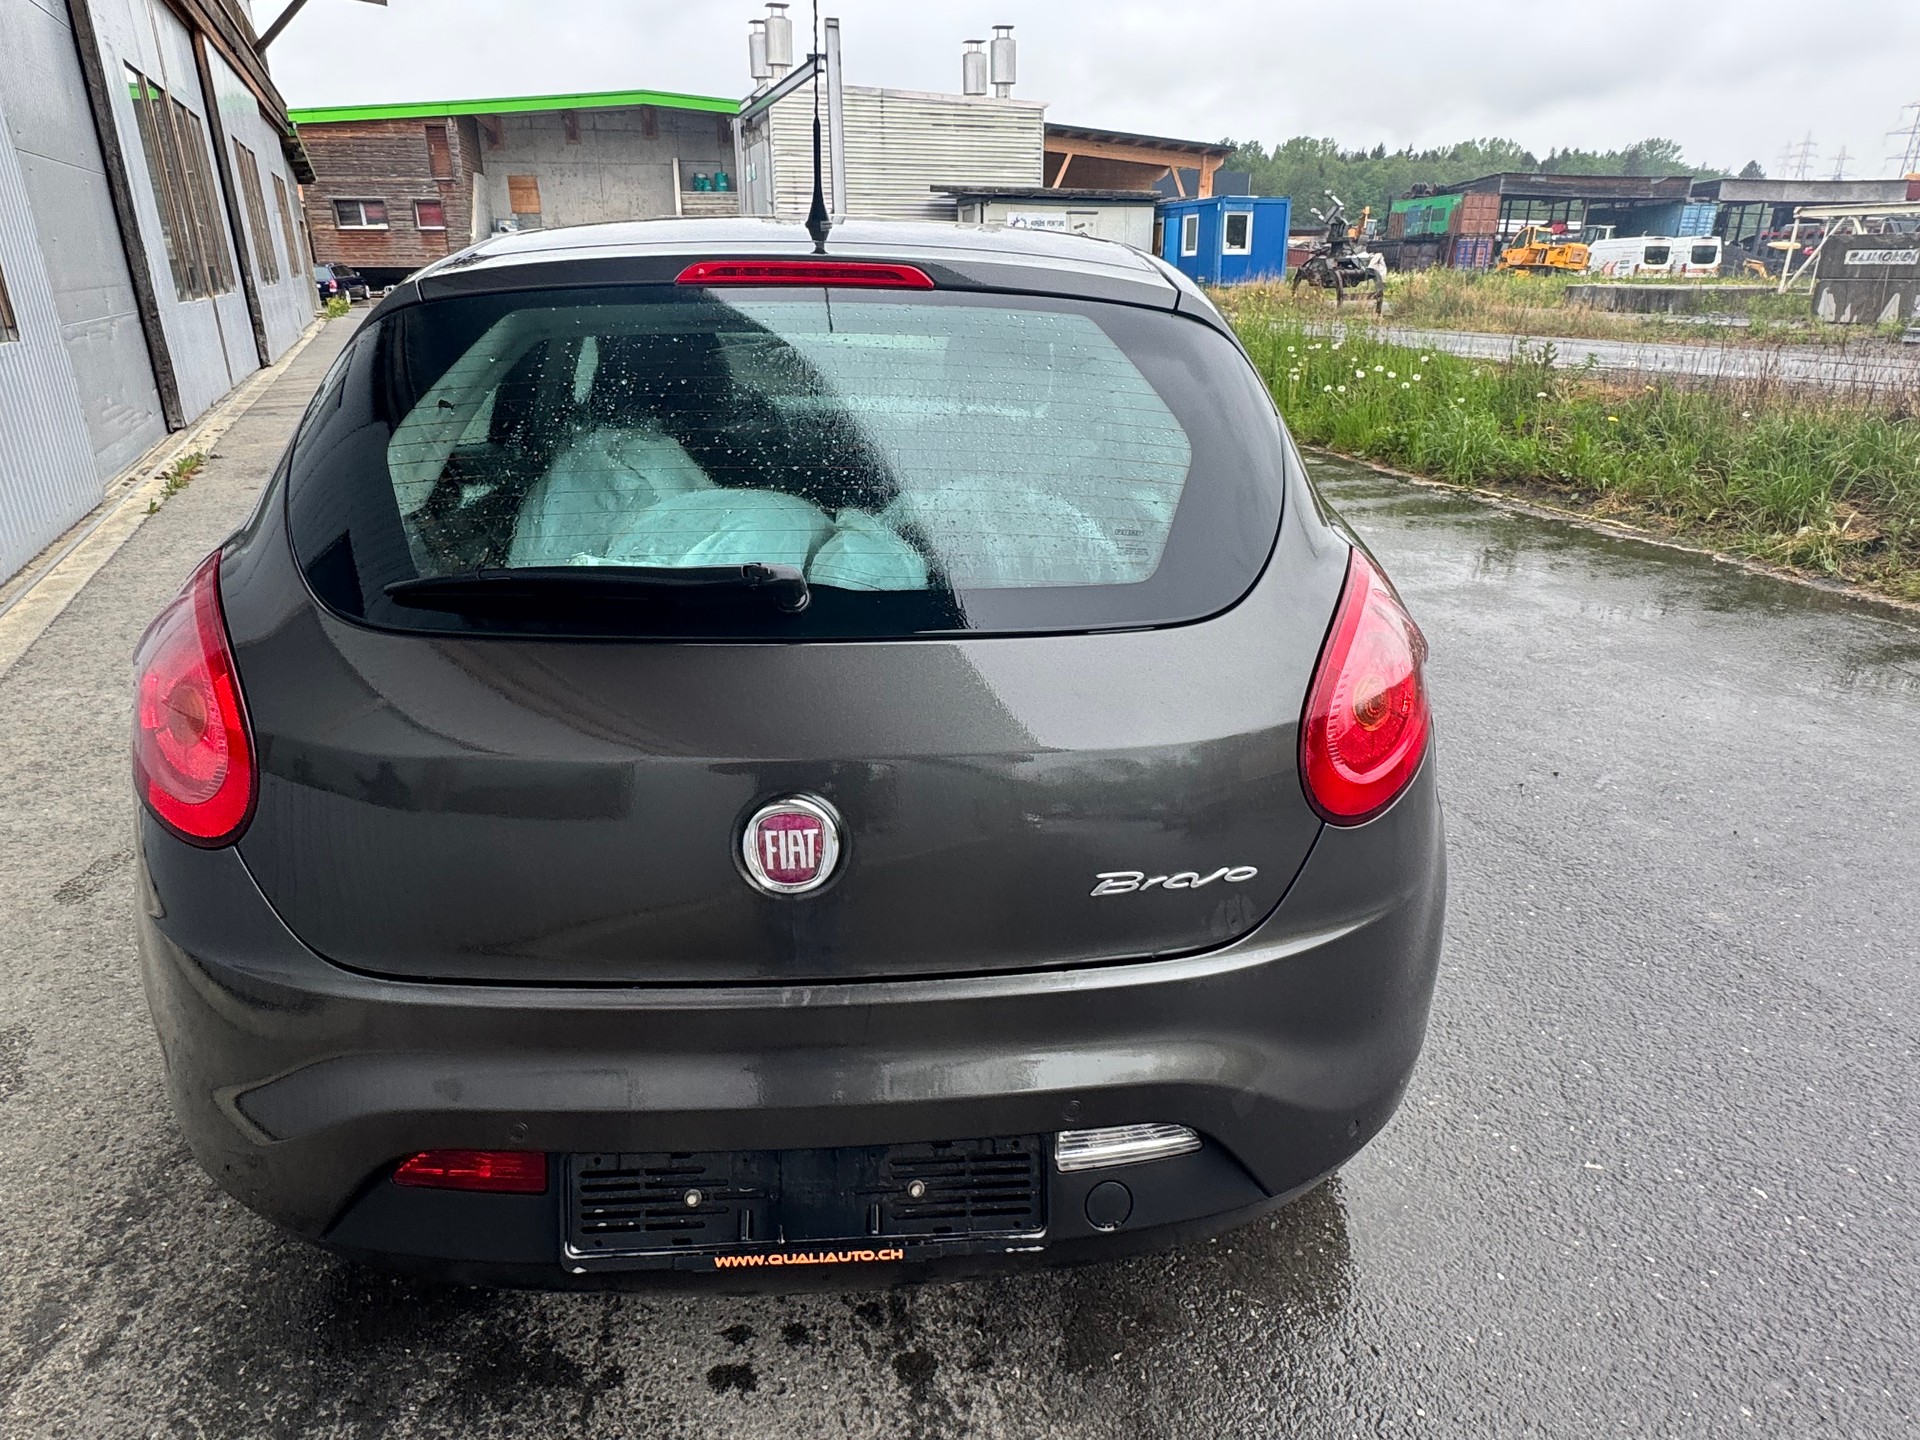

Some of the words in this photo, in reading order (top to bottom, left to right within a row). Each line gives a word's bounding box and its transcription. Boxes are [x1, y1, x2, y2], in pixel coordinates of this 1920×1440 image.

[764, 828, 818, 870] FIAT
[1089, 865, 1258, 897] Bravo
[714, 1248, 904, 1268] WWW.QUALIAUTO.CH
